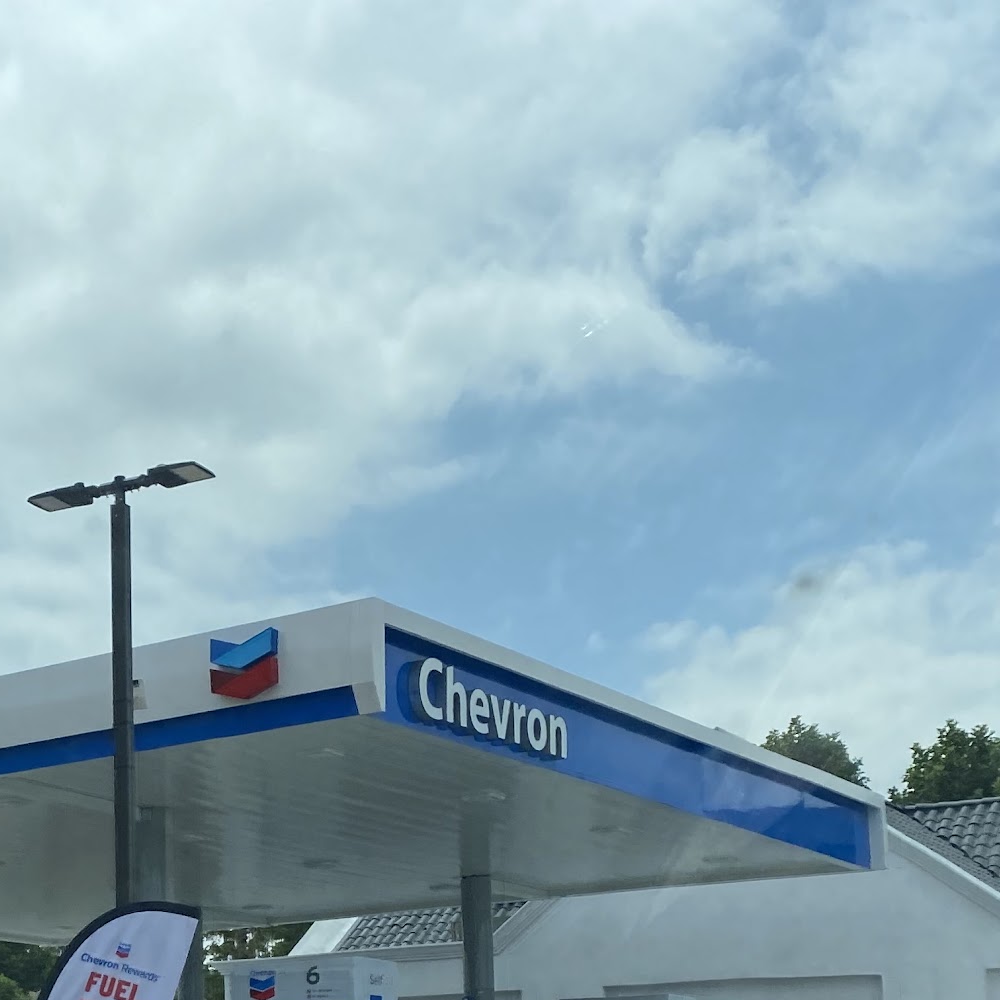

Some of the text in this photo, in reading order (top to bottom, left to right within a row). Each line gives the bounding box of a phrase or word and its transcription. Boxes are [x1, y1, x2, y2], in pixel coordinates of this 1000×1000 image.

[419, 657, 568, 760] Chevron
[81, 953, 119, 970] Chevron
[306, 965, 320, 985] 6
